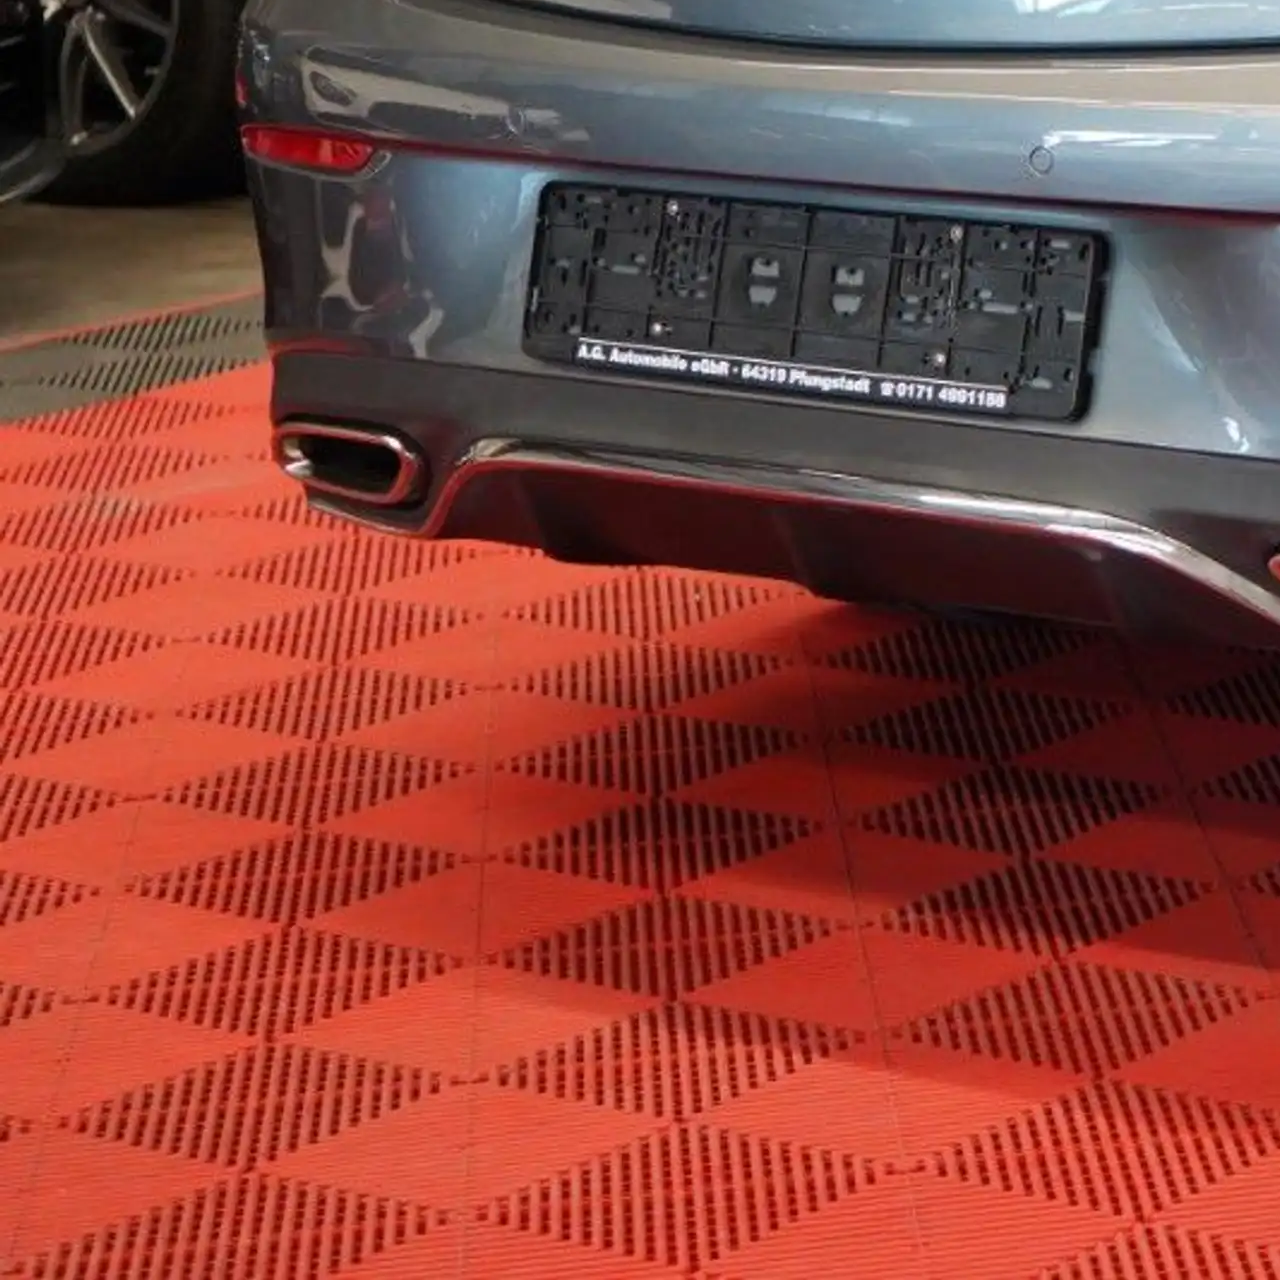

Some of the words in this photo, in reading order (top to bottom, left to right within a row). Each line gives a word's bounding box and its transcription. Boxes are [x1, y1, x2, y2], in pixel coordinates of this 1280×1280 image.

[608, 347, 687, 371] Automobile
[789, 368, 871, 394] Pfungstadt
[896, 381, 934, 401] 0171
